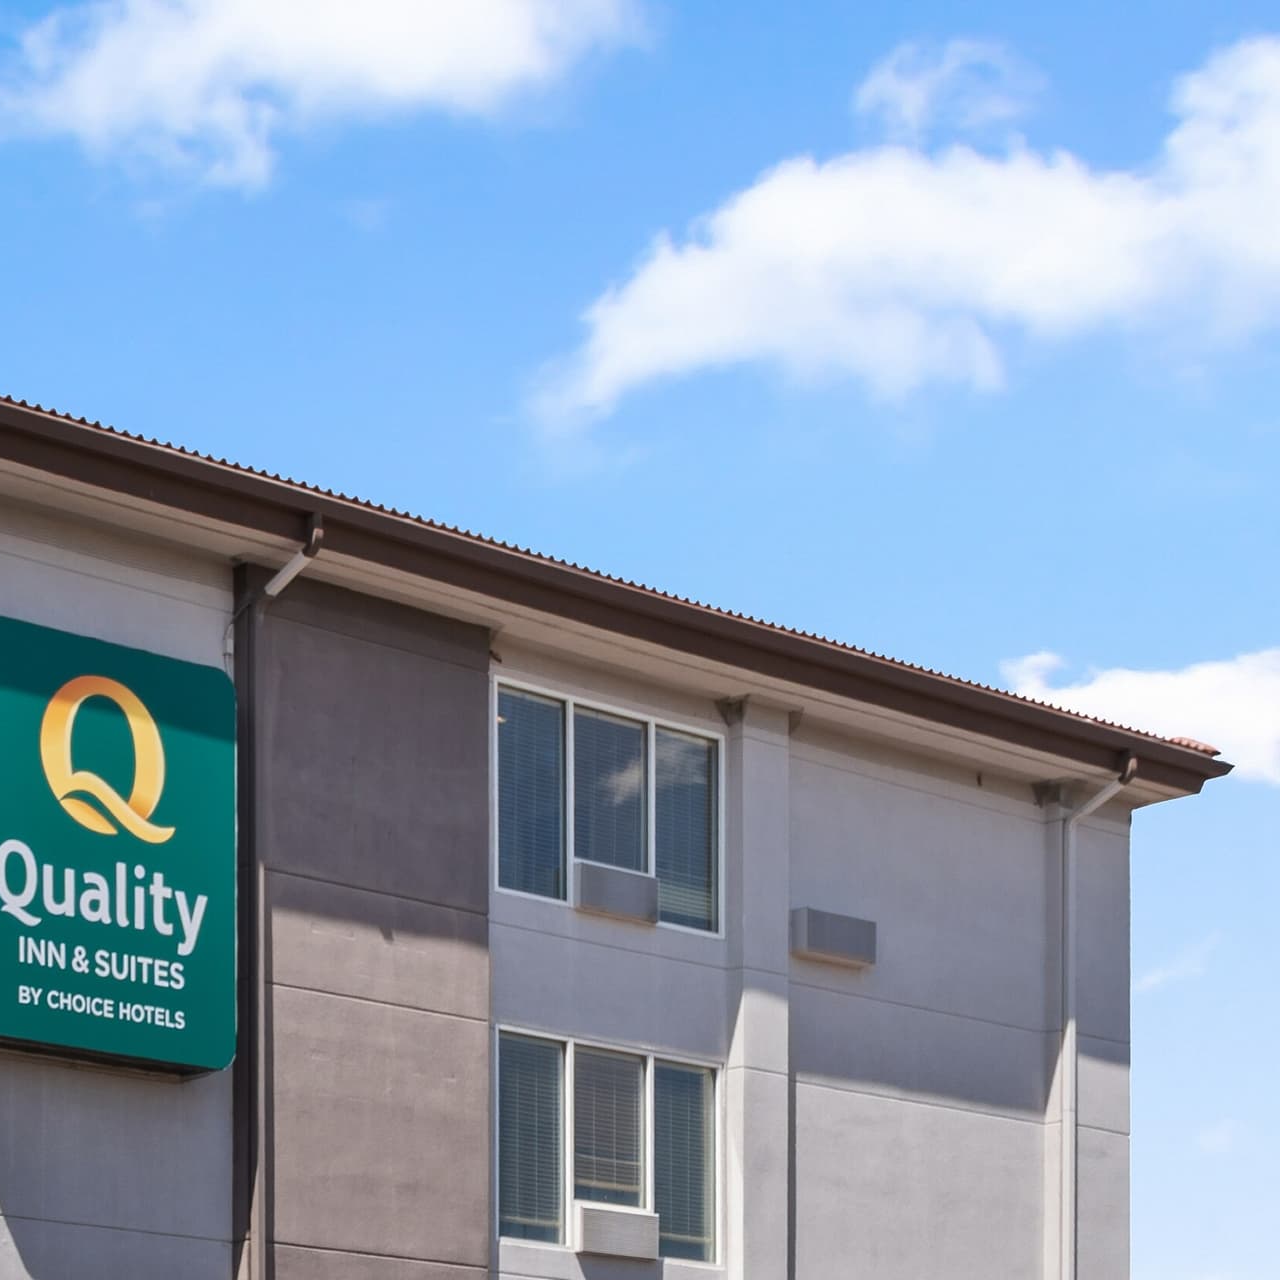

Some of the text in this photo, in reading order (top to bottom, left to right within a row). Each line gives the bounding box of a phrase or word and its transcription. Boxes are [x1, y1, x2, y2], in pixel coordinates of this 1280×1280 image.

[40, 675, 176, 844] Q
[18, 935, 185, 990] INN & SUITES
[18, 985, 186, 1030] BY CHOICE HOTELS
